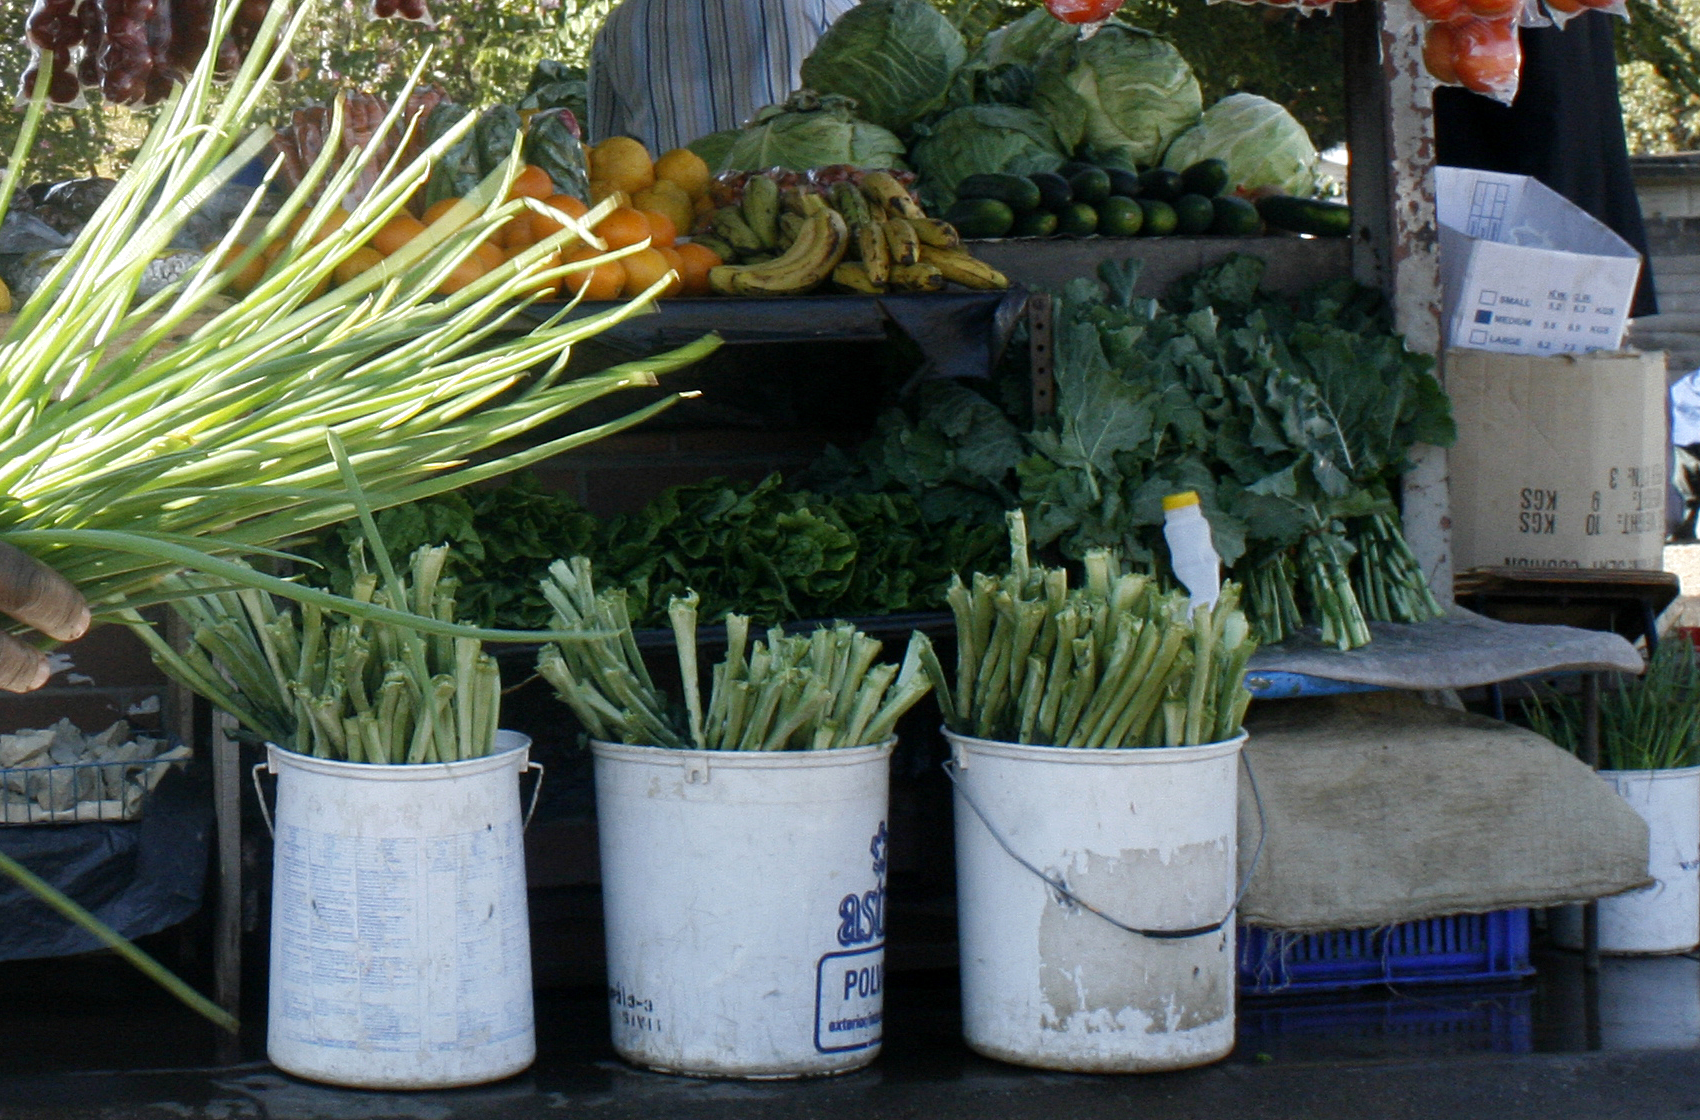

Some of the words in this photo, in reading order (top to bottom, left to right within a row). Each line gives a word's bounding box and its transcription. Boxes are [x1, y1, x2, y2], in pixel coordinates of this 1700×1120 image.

[1500, 296, 1530, 307] SMALL
[1494, 315, 1531, 326] MEDIUM
[1489, 335, 1521, 346] LARGE
[1609, 467, 1619, 490] 3
[1519, 487, 1559, 511] KGS
[1591, 490, 1601, 512] 9
[1518, 512, 1557, 535] KGS
[1585, 513, 1601, 536] 10
